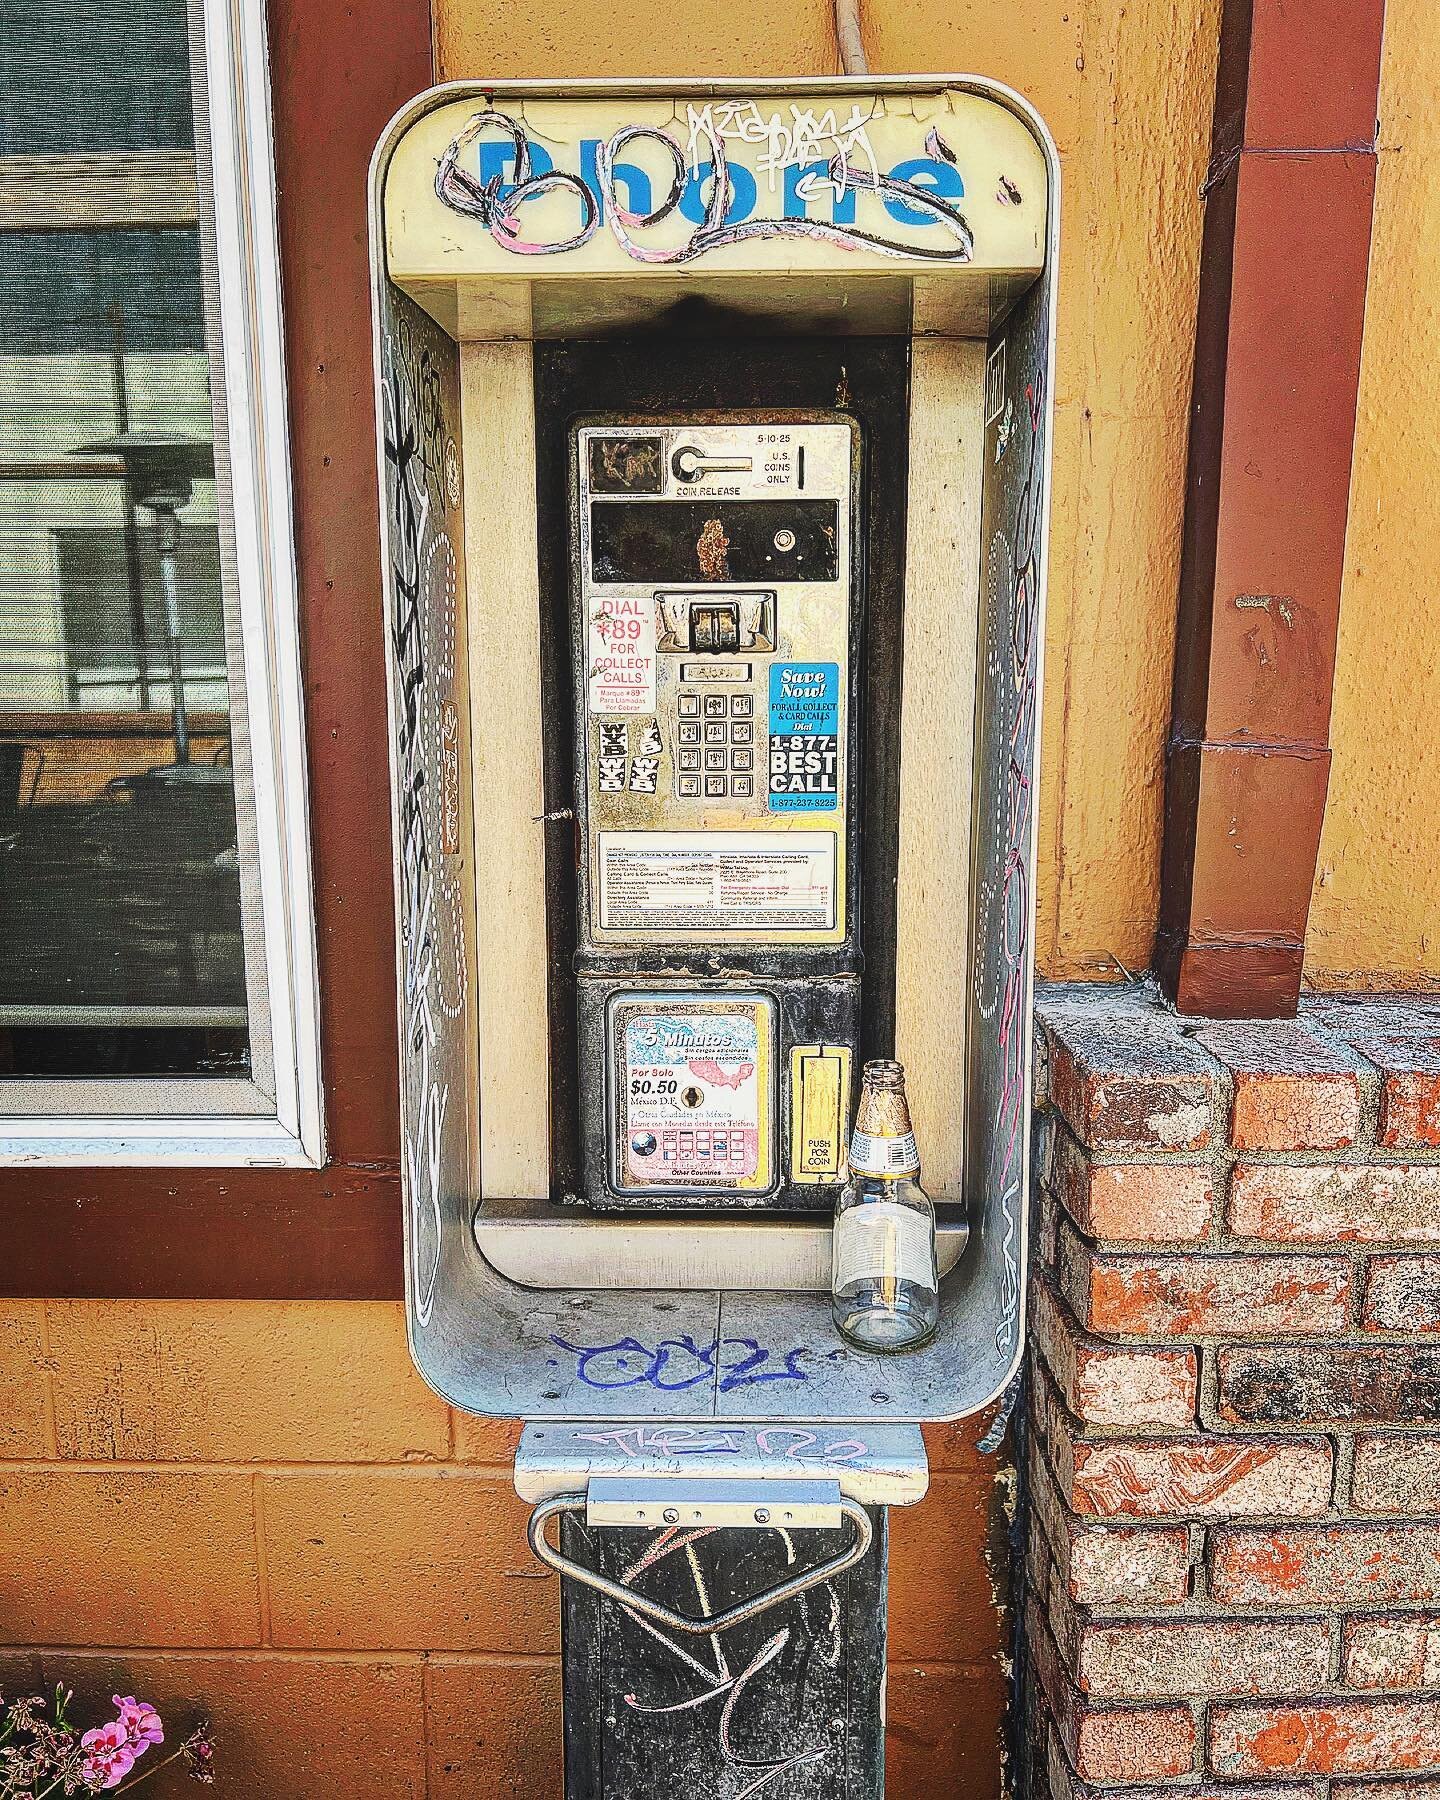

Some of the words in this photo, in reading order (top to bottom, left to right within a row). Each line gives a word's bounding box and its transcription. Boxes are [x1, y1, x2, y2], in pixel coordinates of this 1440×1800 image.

[476, 138, 965, 229] Phone
[772, 452, 790, 461] U.S.
[764, 463, 790, 472] COINS
[767, 475, 790, 484] ONLY
[676, 487, 697, 497] COIN
[699, 486, 741, 496] RELEASE
[602, 600, 644, 615] DIAL
[610, 643, 635, 654] FOR
[595, 657, 651, 669] COLLECT
[603, 672, 642, 683] CALLS
[780, 668, 826, 685] Save
[780, 683, 827, 699] Now!
[803, 702, 837, 712] COLLECT
[778, 712, 785, 721] &
[786, 712, 806, 721] CARD
[806, 712, 831, 721] CALLS
[793, 722, 813, 731] Dial
[771, 735, 836, 751] 1-877-
[771, 751, 837, 775] BEST
[770, 774, 836, 793] CALL
[771, 798, 836, 807] 1-877-237-8225
[645, 1028, 659, 1047] 5
[664, 1031, 733, 1048] Minutos
[631, 1068, 650, 1077] Por
[651, 1068, 674, 1077] Solo
[630, 1080, 678, 1096] $0.50
[630, 1097, 658, 1106] México
[808, 1139, 831, 1148] PUSH
[811, 1148, 829, 1157] FOR
[808, 1157, 830, 1166] COIN
